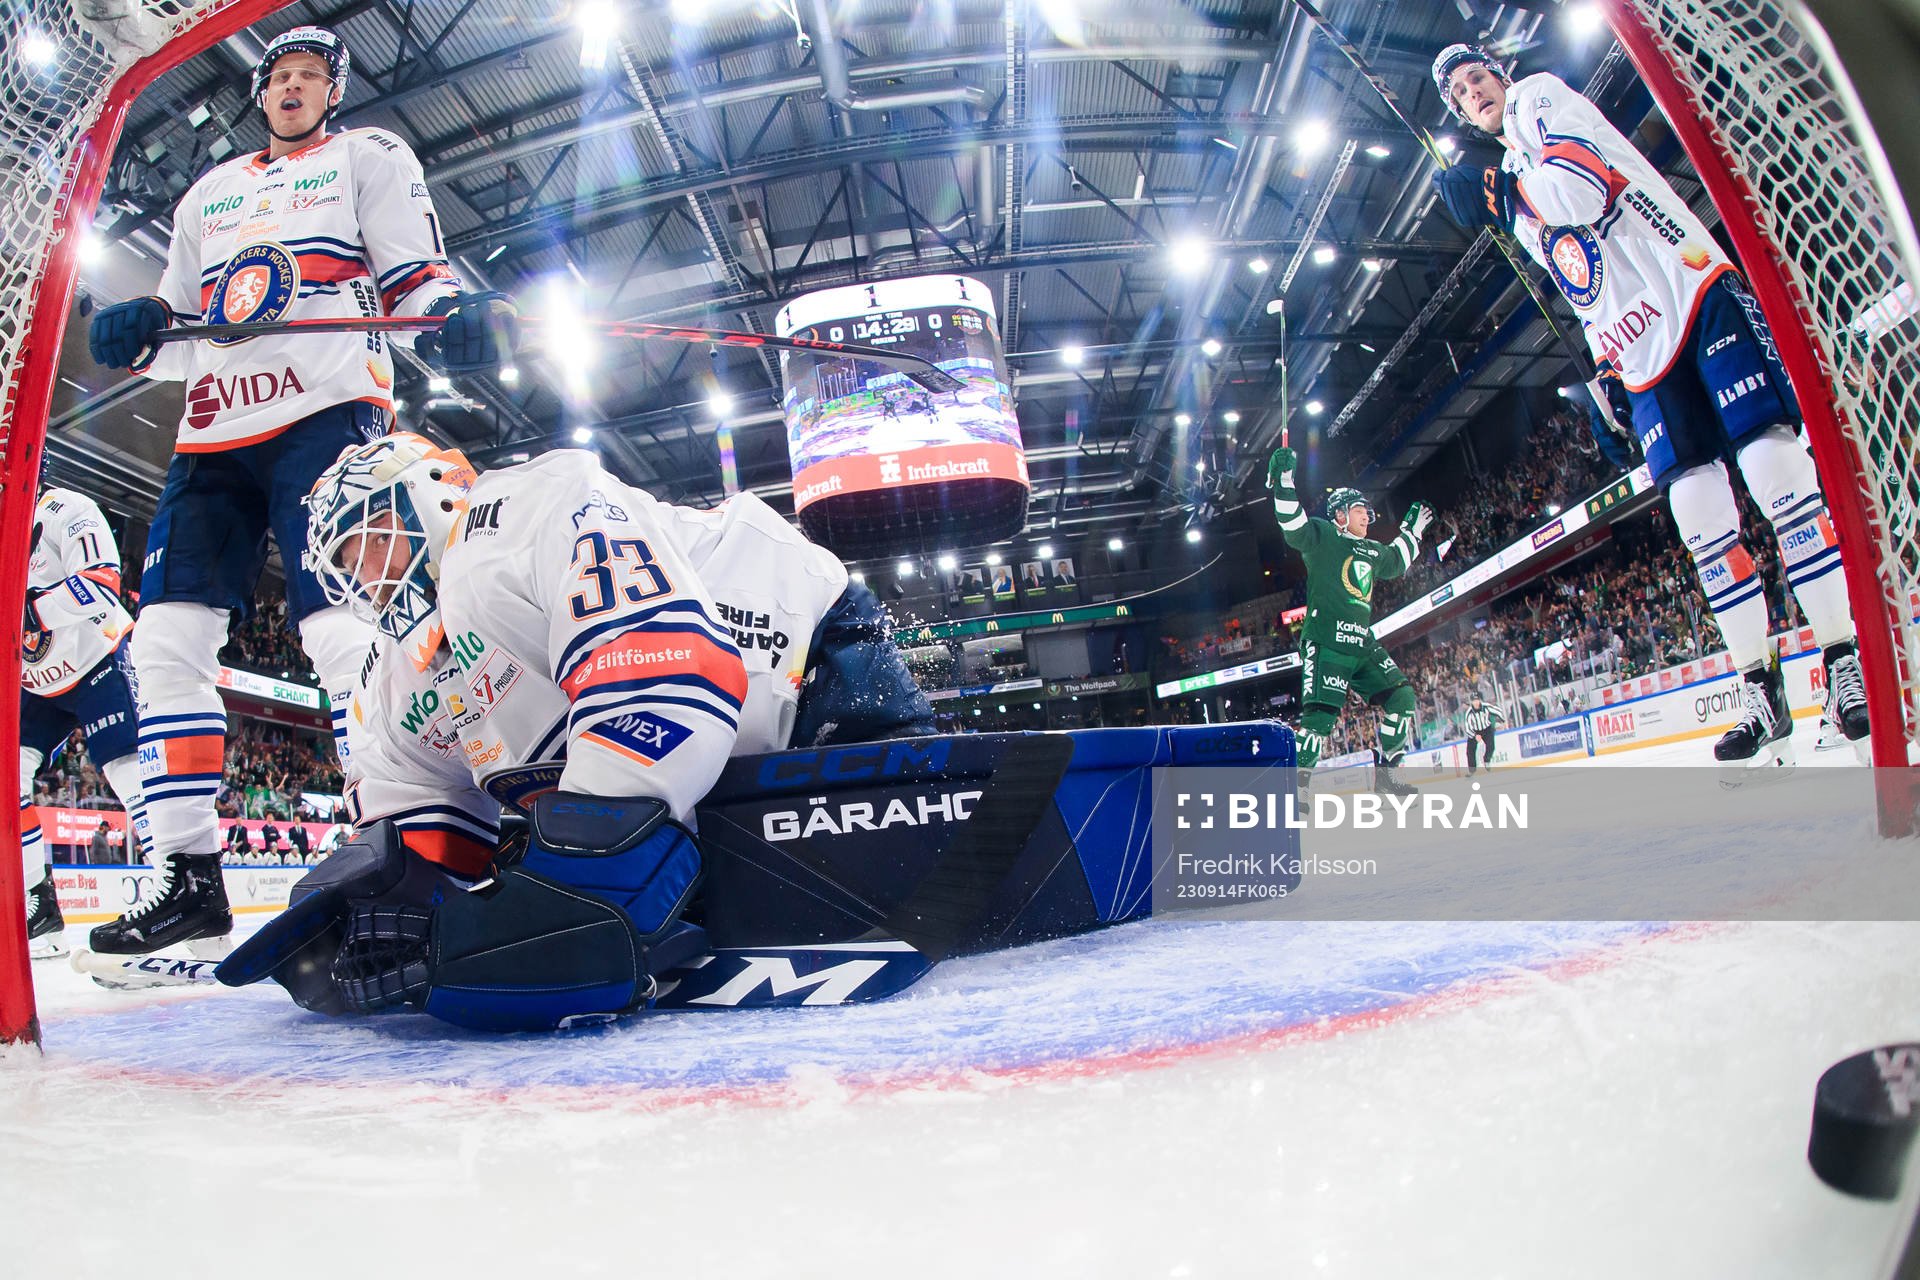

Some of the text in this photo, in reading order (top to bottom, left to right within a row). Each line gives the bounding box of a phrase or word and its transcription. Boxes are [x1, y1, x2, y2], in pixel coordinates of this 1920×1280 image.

[265, 166, 285, 178] SHL
[294, 170, 338, 191] wilo
[203, 195, 244, 218] wilo
[1634, 189, 1686, 239] ON FIRE
[1624, 193, 1680, 247] BOARDS
[229, 247, 268, 271] LAKERS
[268, 250, 292, 291] HOCKEY
[864, 284, 882, 308] 1
[954, 278, 972, 301] 1
[829, 326, 844, 342] 0
[857, 316, 917, 339] 14:29
[927, 314, 943, 329] 0
[1603, 300, 1662, 352] VIDA
[1706, 333, 1737, 356] CCM
[216, 366, 305, 409] VIDA
[1716, 372, 1767, 408] ÄLMBY
[907, 458, 990, 481] Infrakraft
[1772, 492, 1795, 509] CCM
[464, 498, 503, 542] put
[79, 533, 101, 563] 11
[1787, 525, 1819, 550] STENA
[568, 529, 675, 622] 33
[70, 577, 90, 603] ALWEX
[715, 602, 770, 629] FIRE
[361, 641, 380, 690] put
[597, 648, 692, 670] Elitfönster
[29, 660, 77, 688] VIDA
[494, 663, 519, 693] PRODUKT
[1064, 680, 1117, 693] The Wolfpack
[273, 685, 310, 705] SCHAKT
[455, 712, 480, 731] ALCO
[1596, 713, 1635, 738] MAXI
[758, 739, 952, 789] CCM
